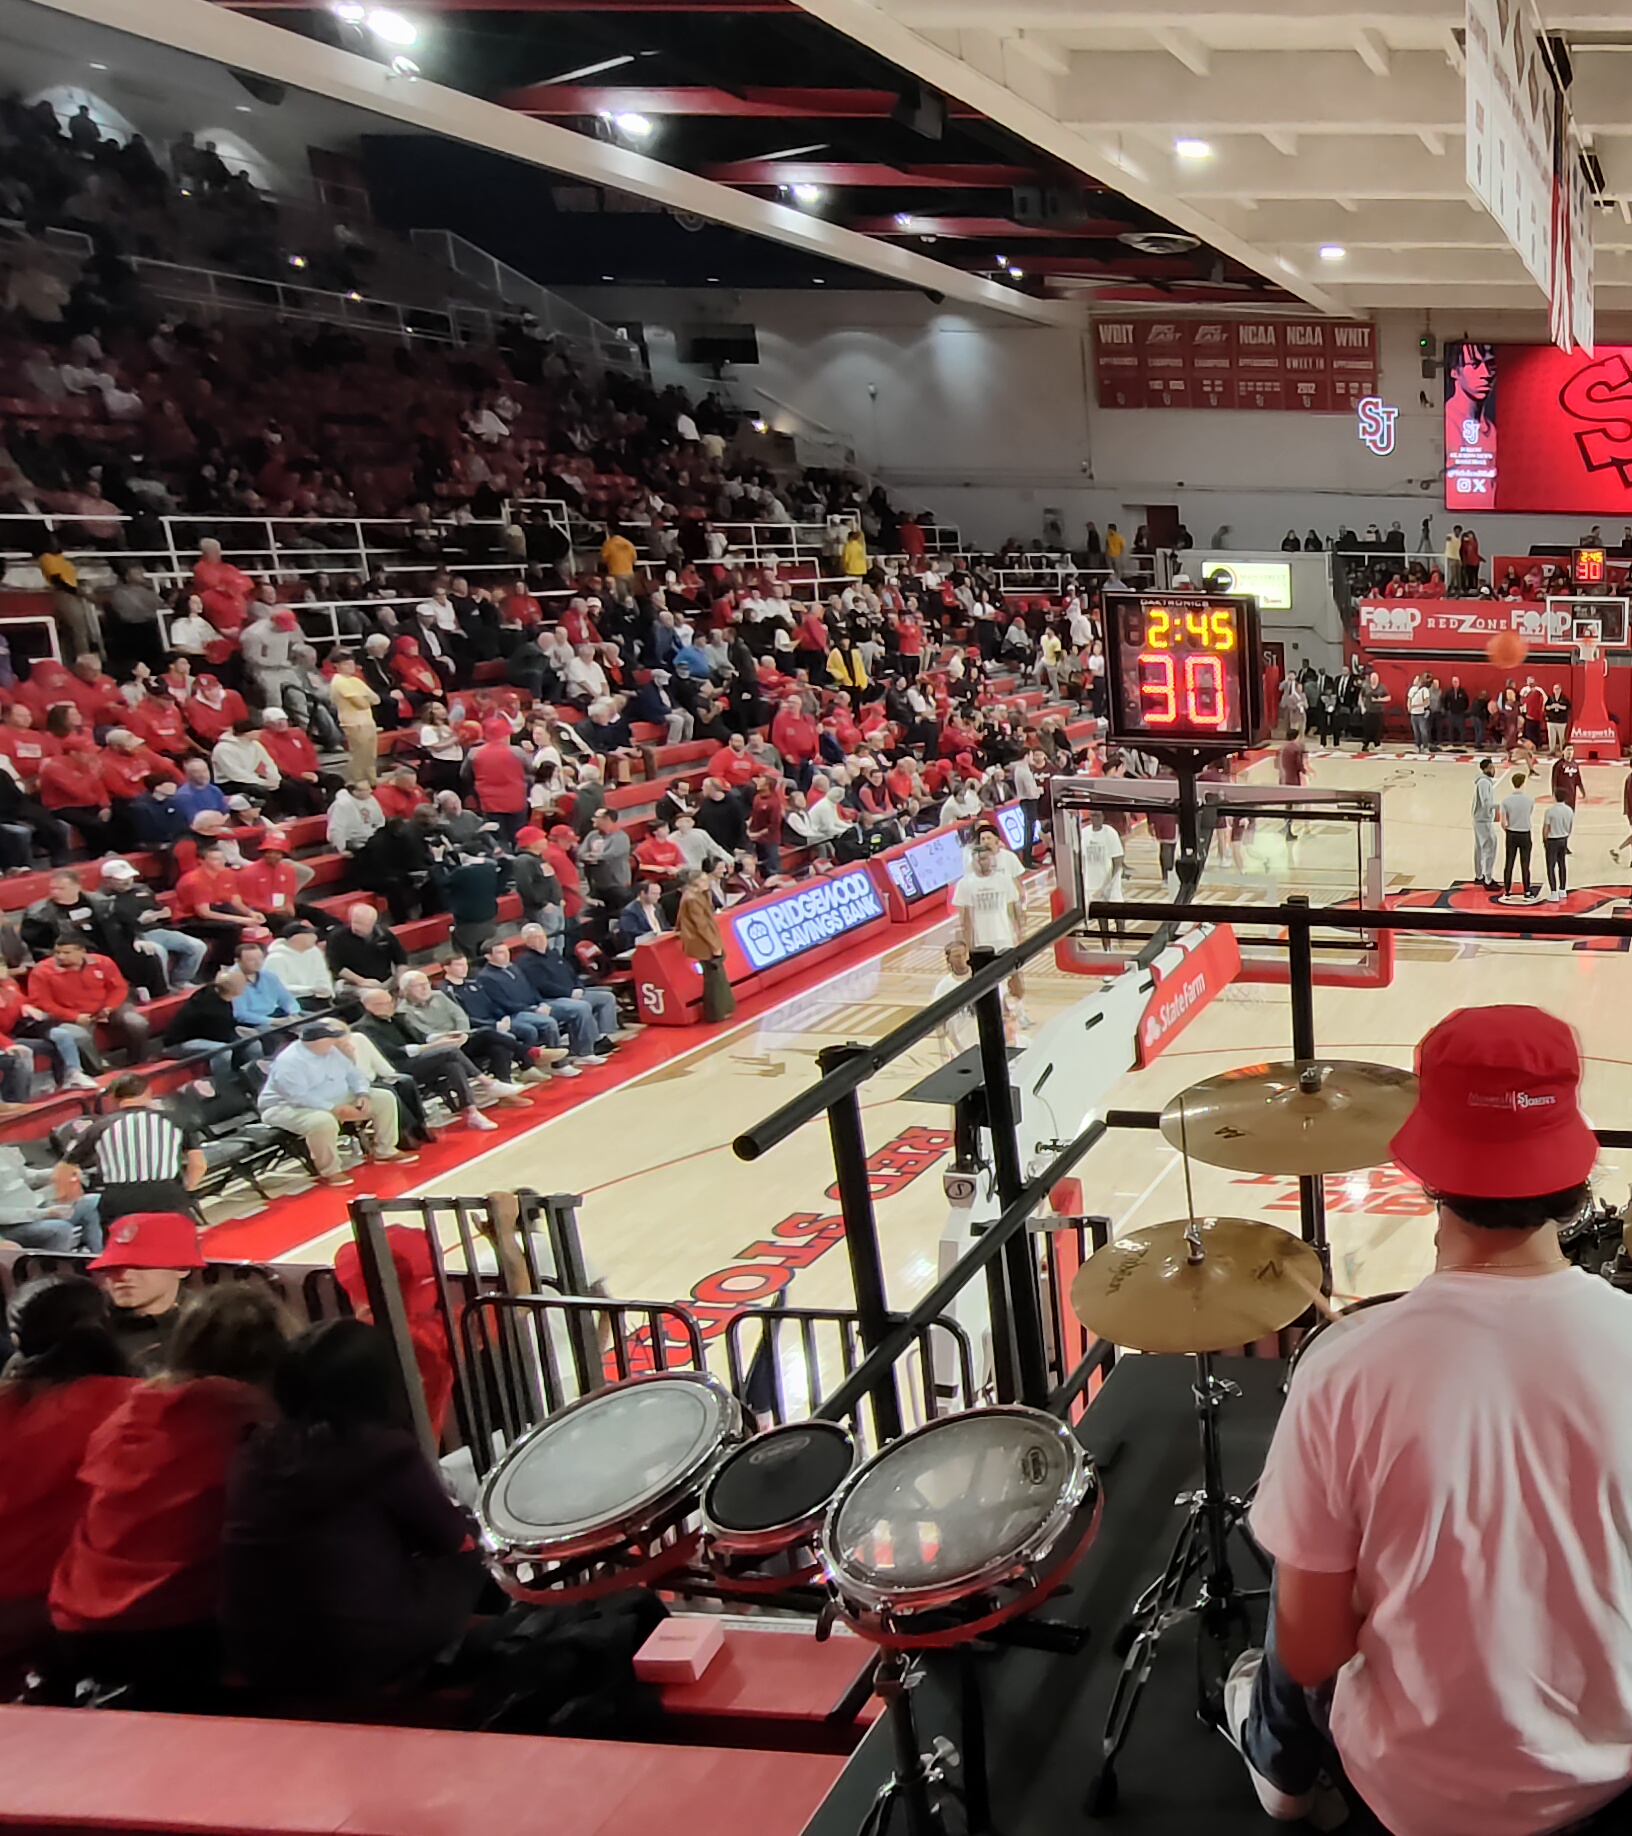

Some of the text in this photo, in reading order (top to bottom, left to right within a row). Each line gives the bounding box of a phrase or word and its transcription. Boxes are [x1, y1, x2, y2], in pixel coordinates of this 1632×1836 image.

[1239, 325, 1276, 345] NCAA
[1287, 326, 1323, 346] NCAA
[1334, 327, 1371, 347] WNIT
[1581, 552, 1603, 562] 2:45
[1578, 562, 1601, 580] 30
[1361, 606, 1422, 628] FOOD
[1511, 609, 1572, 631] FOOD
[1147, 609, 1234, 650] 2:45
[1138, 653, 1227, 725] 30
[768, 870, 871, 933] RIDGEWOOD
[778, 894, 882, 952] SAVINGS BANK
[826, 1125, 955, 1202] RED
